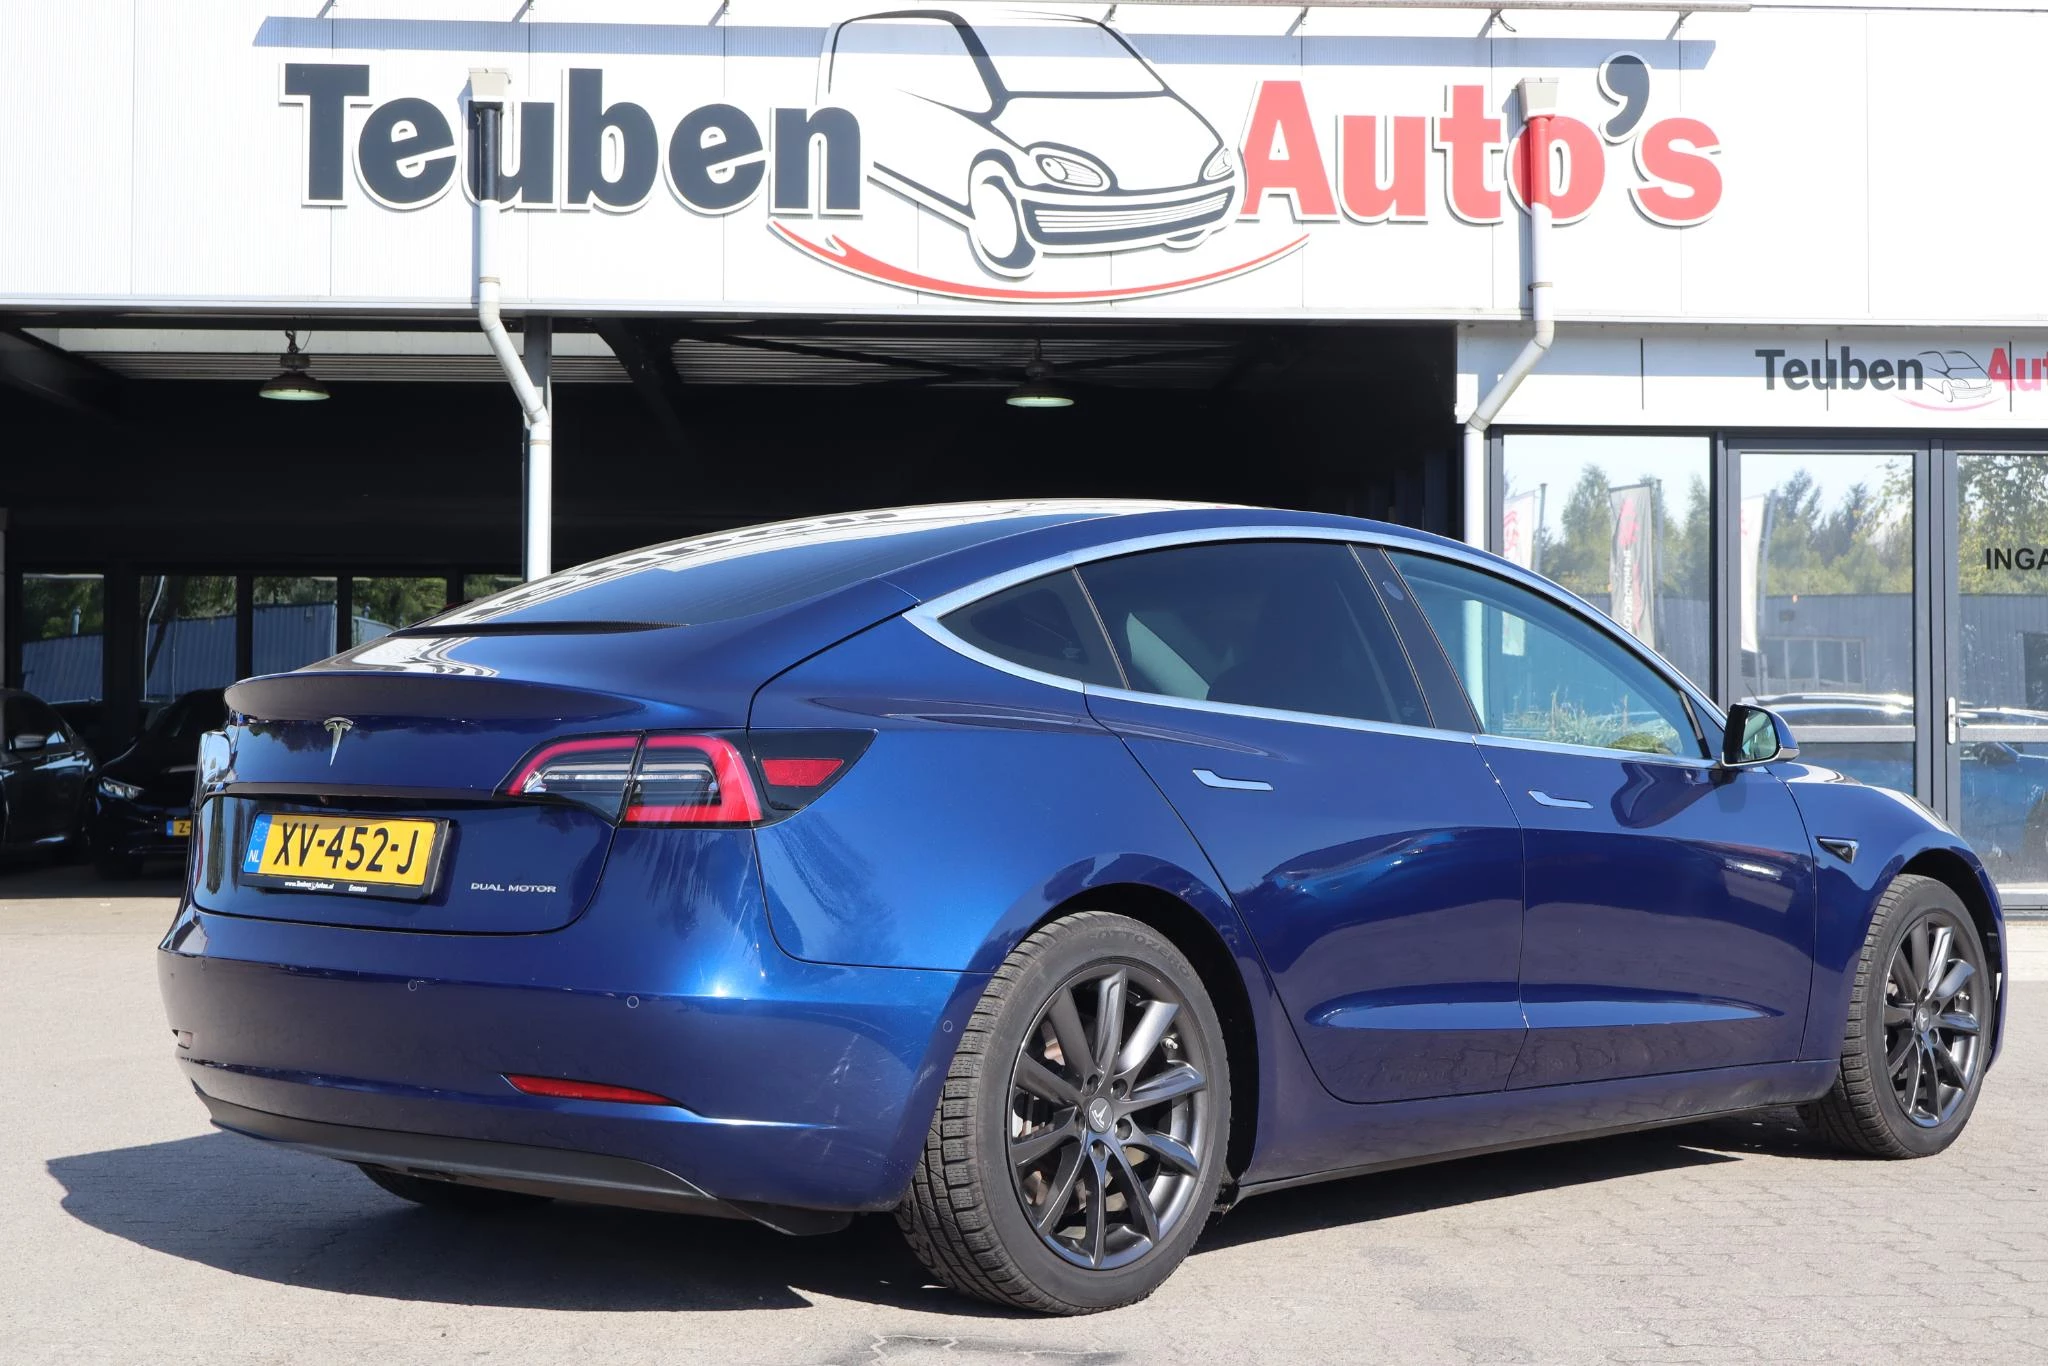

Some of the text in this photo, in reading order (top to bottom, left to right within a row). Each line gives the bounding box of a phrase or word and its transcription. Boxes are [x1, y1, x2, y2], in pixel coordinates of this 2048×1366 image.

[283, 54, 1723, 221] Teuben Auto's
[1755, 345, 1924, 391] Teuben
[248, 849, 260, 863] NL
[273, 822, 419, 875] XV-452-J
[470, 882, 557, 893] DUAL MOTOR
